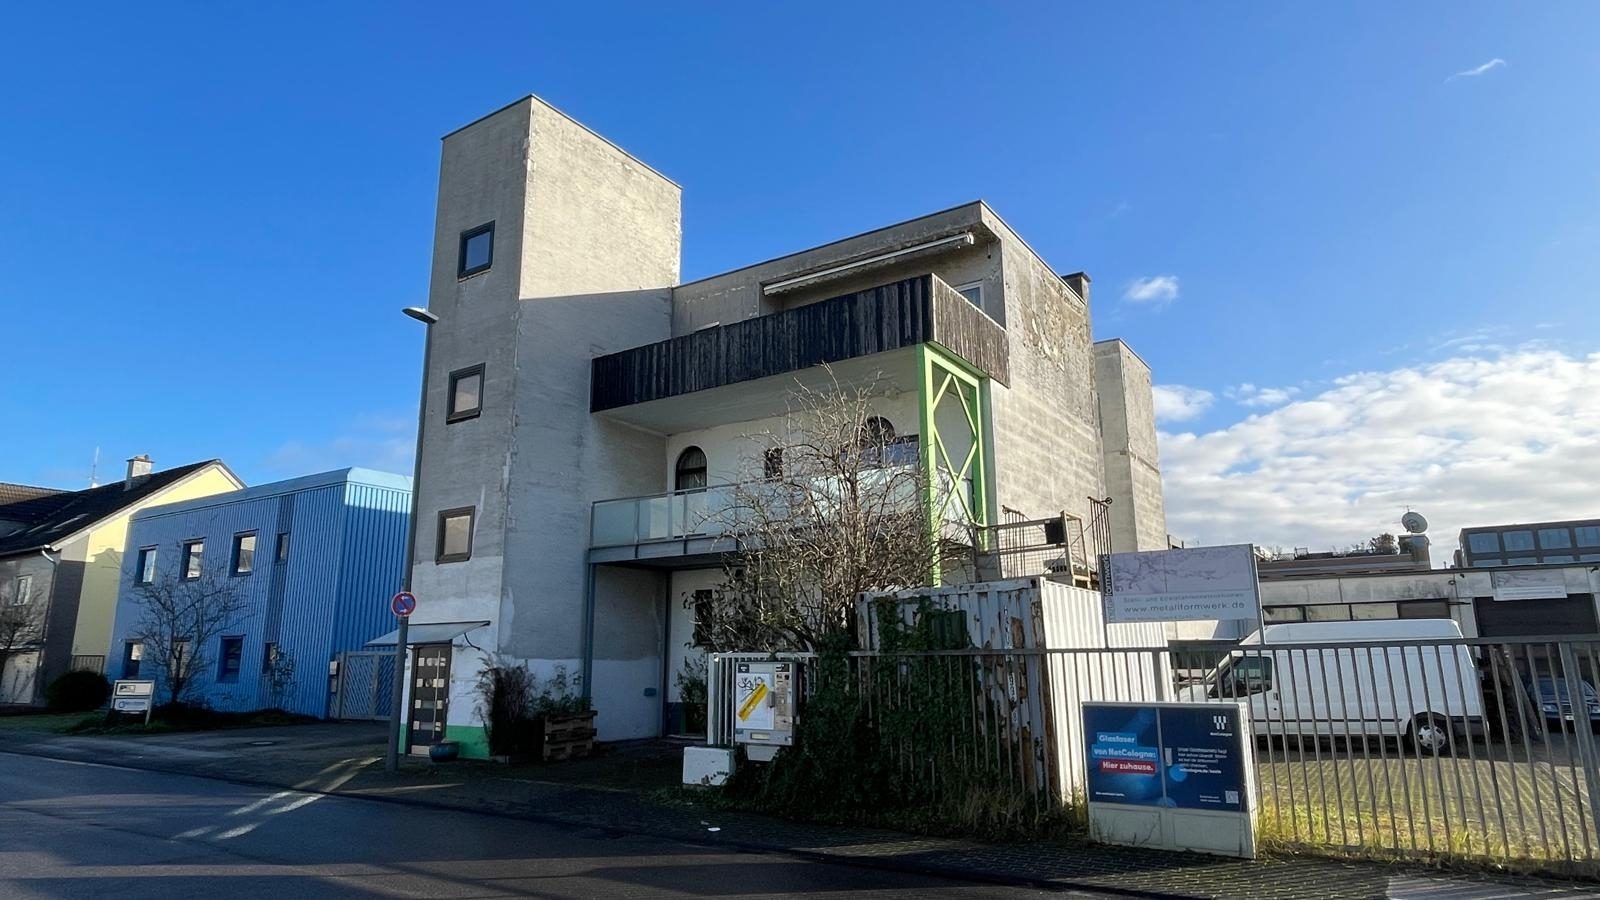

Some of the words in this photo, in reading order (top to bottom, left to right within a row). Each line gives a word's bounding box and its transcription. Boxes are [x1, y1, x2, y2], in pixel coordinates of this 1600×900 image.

[1124, 601, 1245, 612] www.metallformwerk.de
[1098, 734, 1135, 743] Glasfaser
[1093, 748, 1108, 756] von
[1102, 760, 1119, 769] Hier
[1119, 762, 1154, 771] zuhause.
